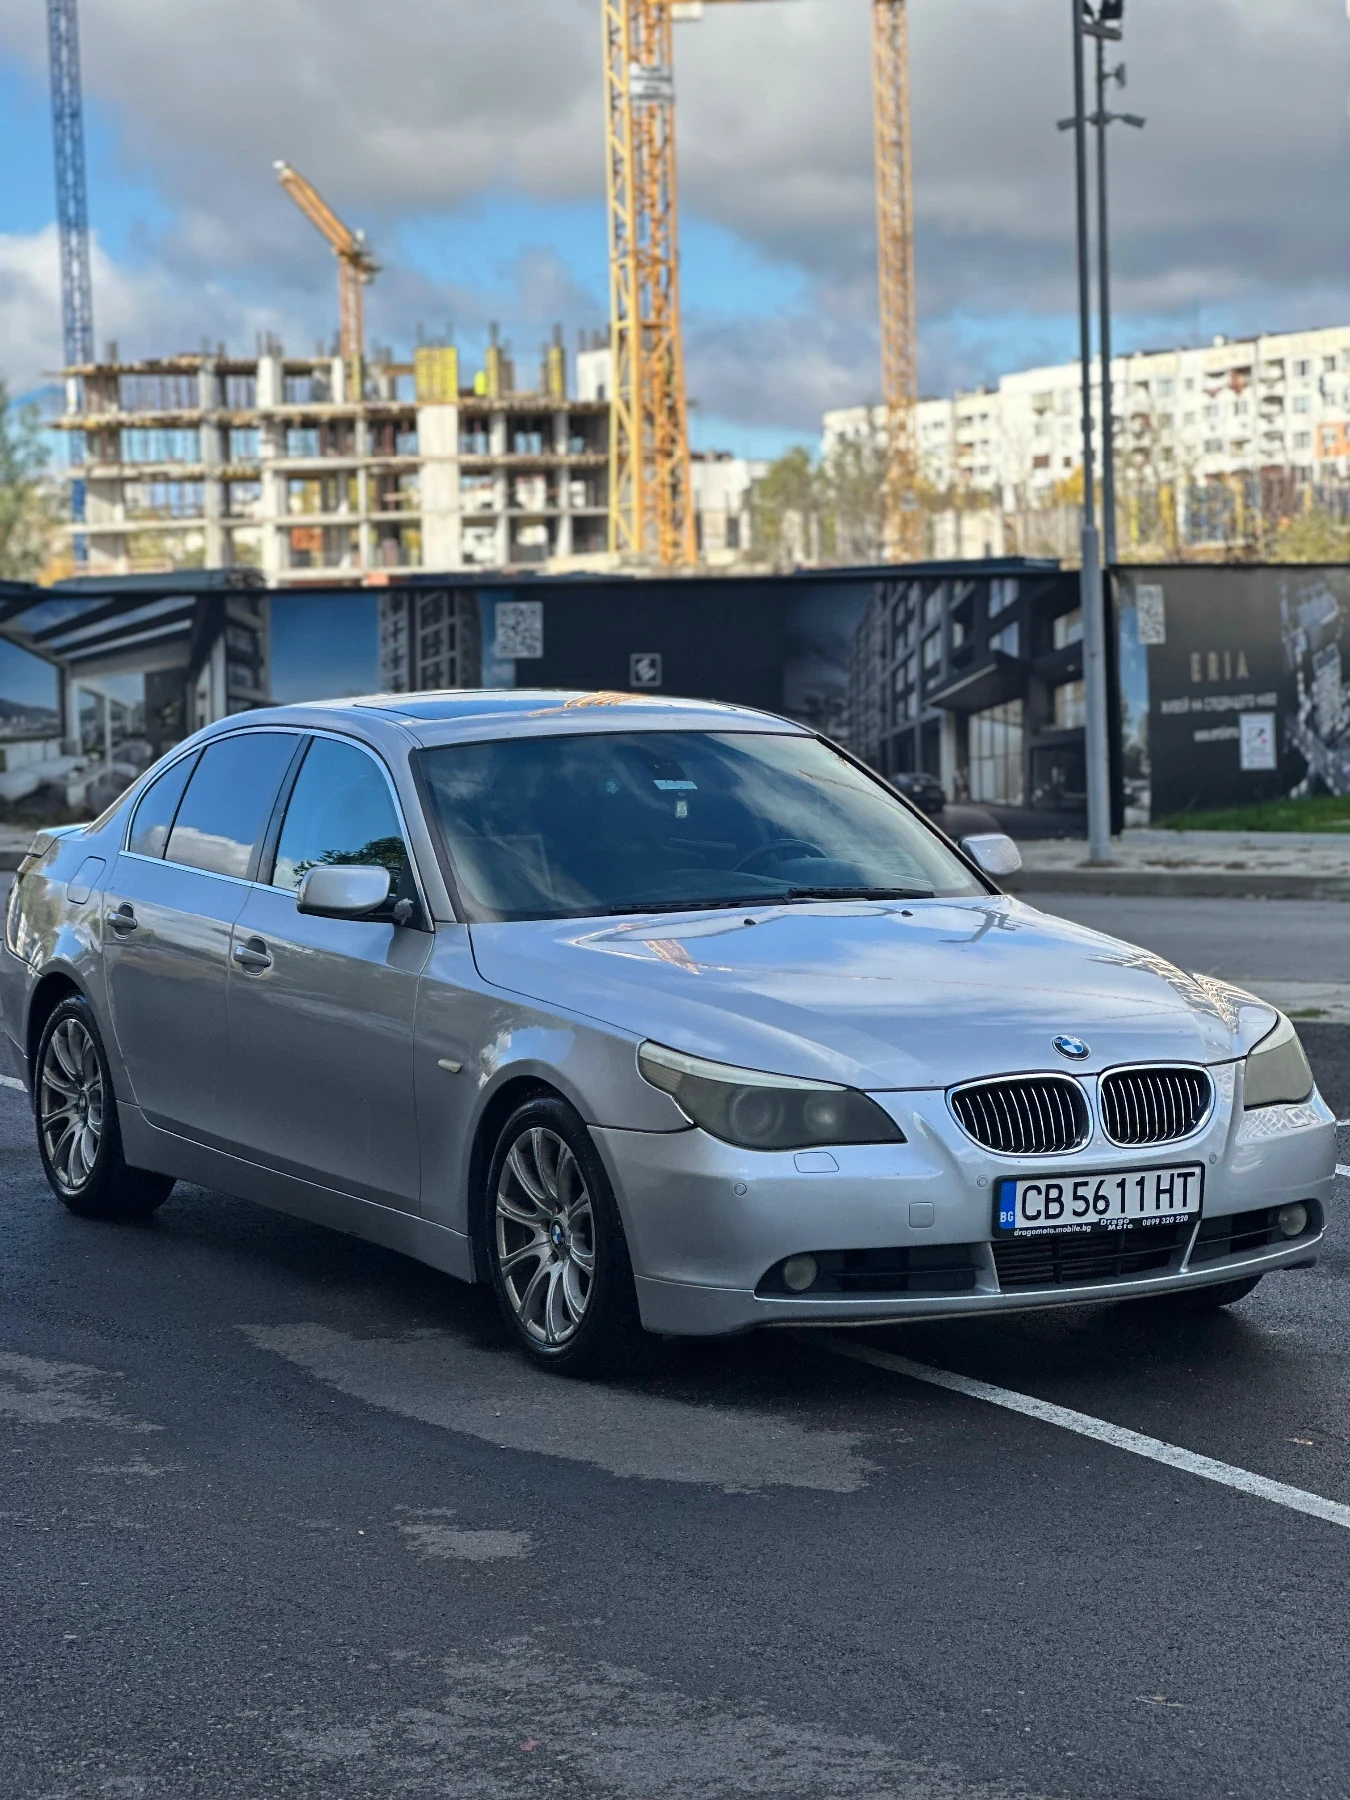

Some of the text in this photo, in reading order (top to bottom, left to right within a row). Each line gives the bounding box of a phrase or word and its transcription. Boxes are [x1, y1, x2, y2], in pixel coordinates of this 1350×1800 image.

[1000, 1211, 1014, 1223] BG
[1100, 1218, 1130, 1226] Drago
[1161, 1216, 1174, 1224] 320
[1175, 1214, 1189, 1223] 220
[1014, 1225, 1092, 1237] dragomoto.mobile.bg
[1107, 1223, 1133, 1231] Moto
